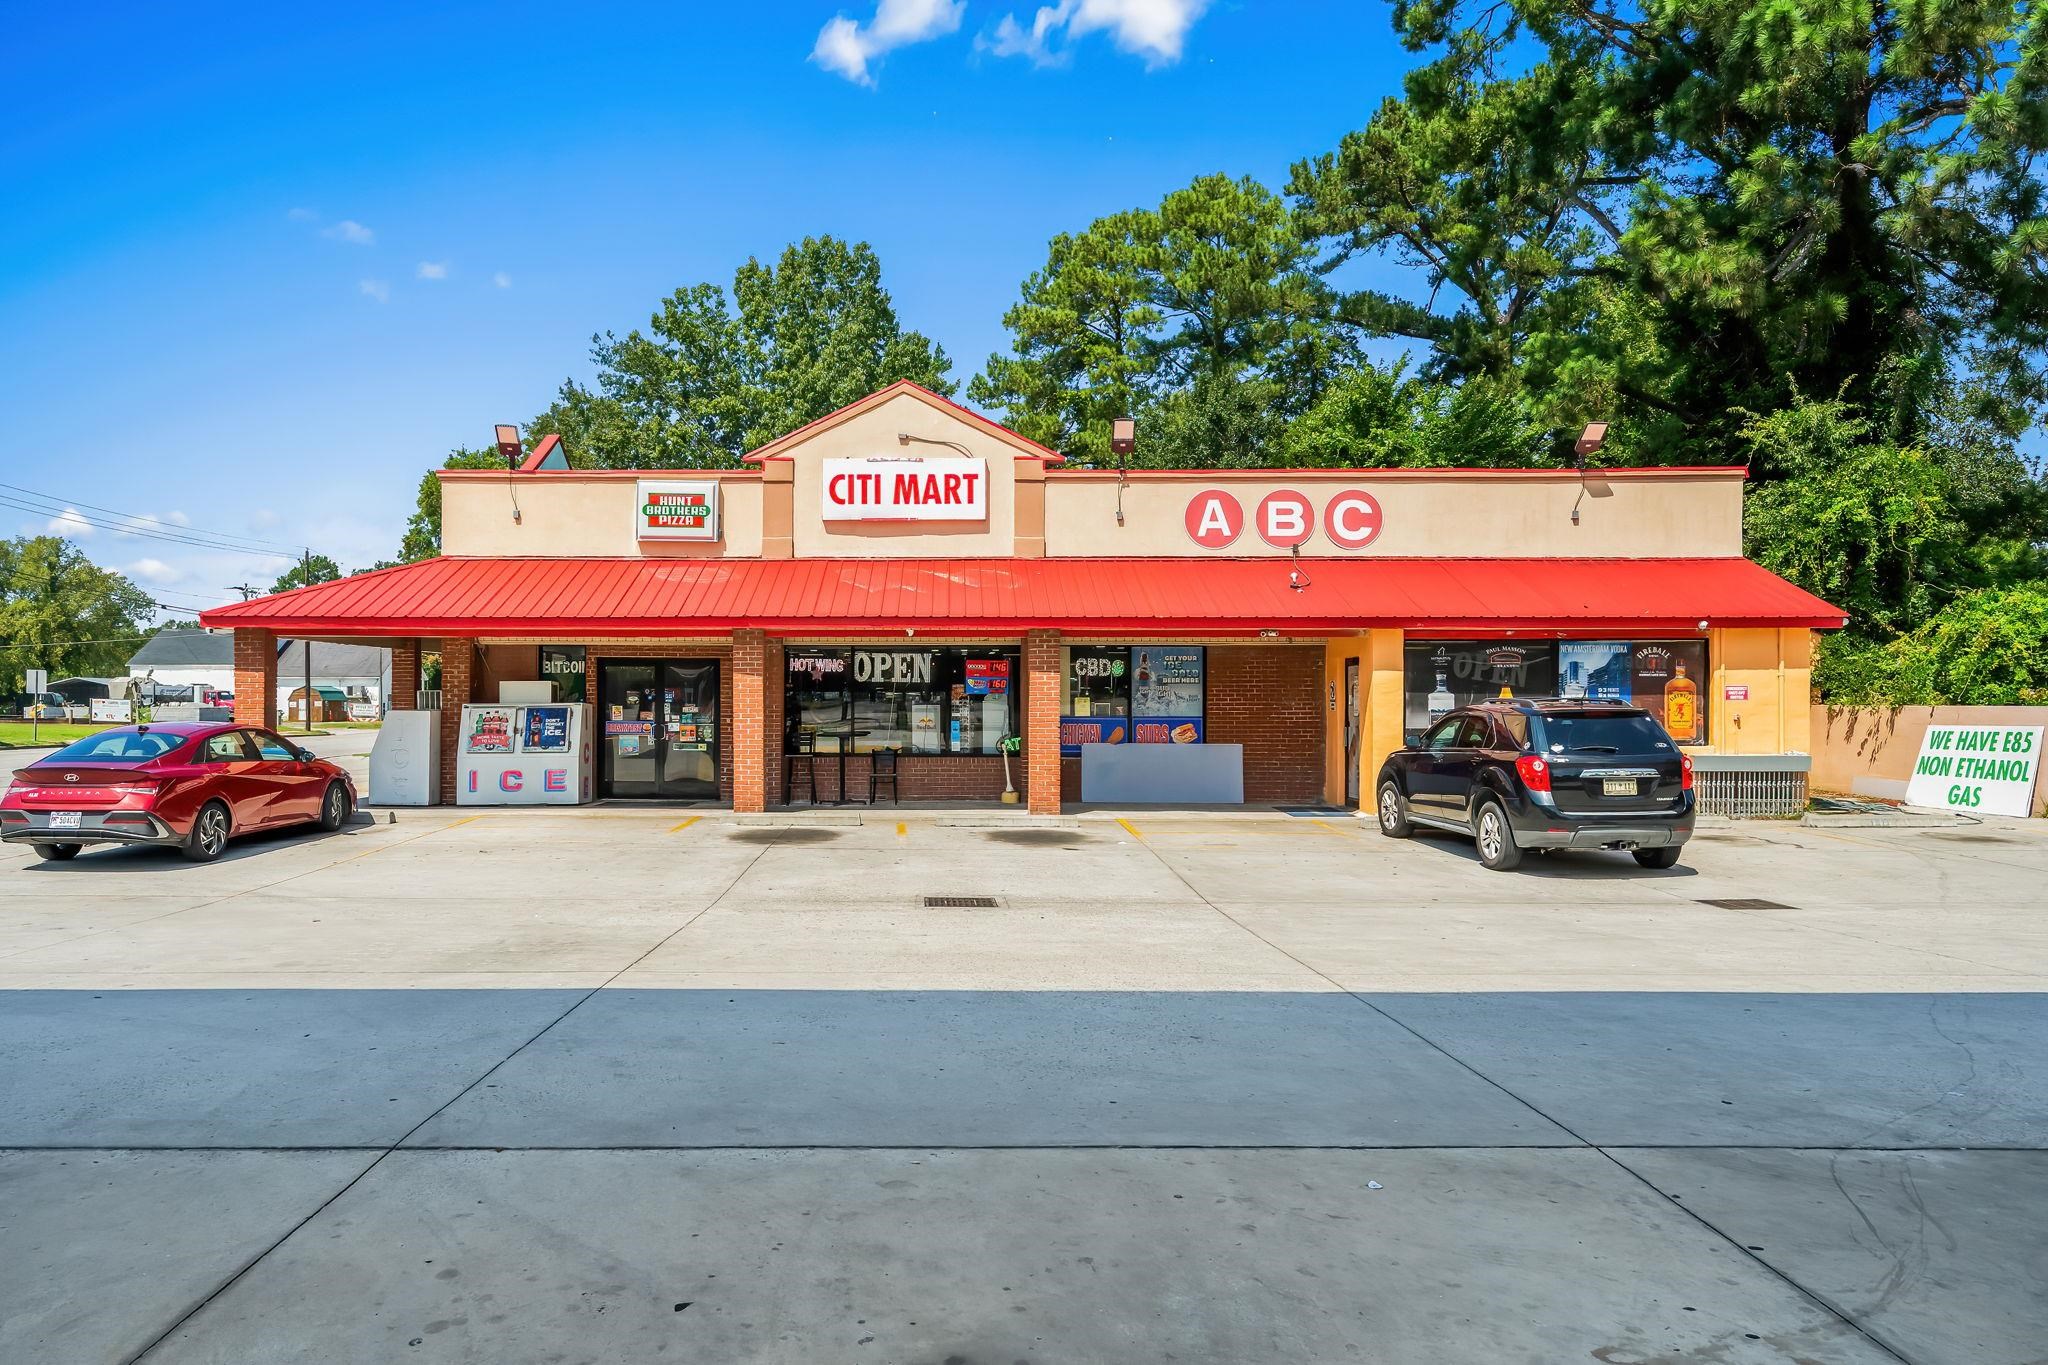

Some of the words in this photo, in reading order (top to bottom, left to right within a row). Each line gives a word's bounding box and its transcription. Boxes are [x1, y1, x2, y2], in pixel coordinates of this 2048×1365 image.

[828, 473, 882, 505] CITI
[892, 473, 979, 505] MART
[659, 496, 693, 505] HUNT
[646, 505, 707, 516] BROTHERS
[659, 515, 694, 526] PIZZA
[1485, 647, 1501, 655] PAUL
[1560, 645, 1573, 653] NEW
[1573, 645, 1610, 653] AMSTERDAM
[1610, 645, 1628, 653] VODKA
[1636, 646, 1671, 660] FIREBALL
[789, 658, 814, 672] HOT
[853, 651, 932, 683] OPEN
[1075, 657, 1112, 677] CBD
[1163, 660, 1183, 670] ICE
[1061, 723, 1102, 746] CHICKEN
[1929, 730, 1955, 751] WE
[1956, 730, 2000, 752] HAVE
[2001, 731, 2034, 754] E85
[1916, 755, 1953, 777] NON
[1954, 757, 2030, 783] ETHANOL
[469, 768, 567, 793] ICE
[1948, 784, 1982, 807] GAS
